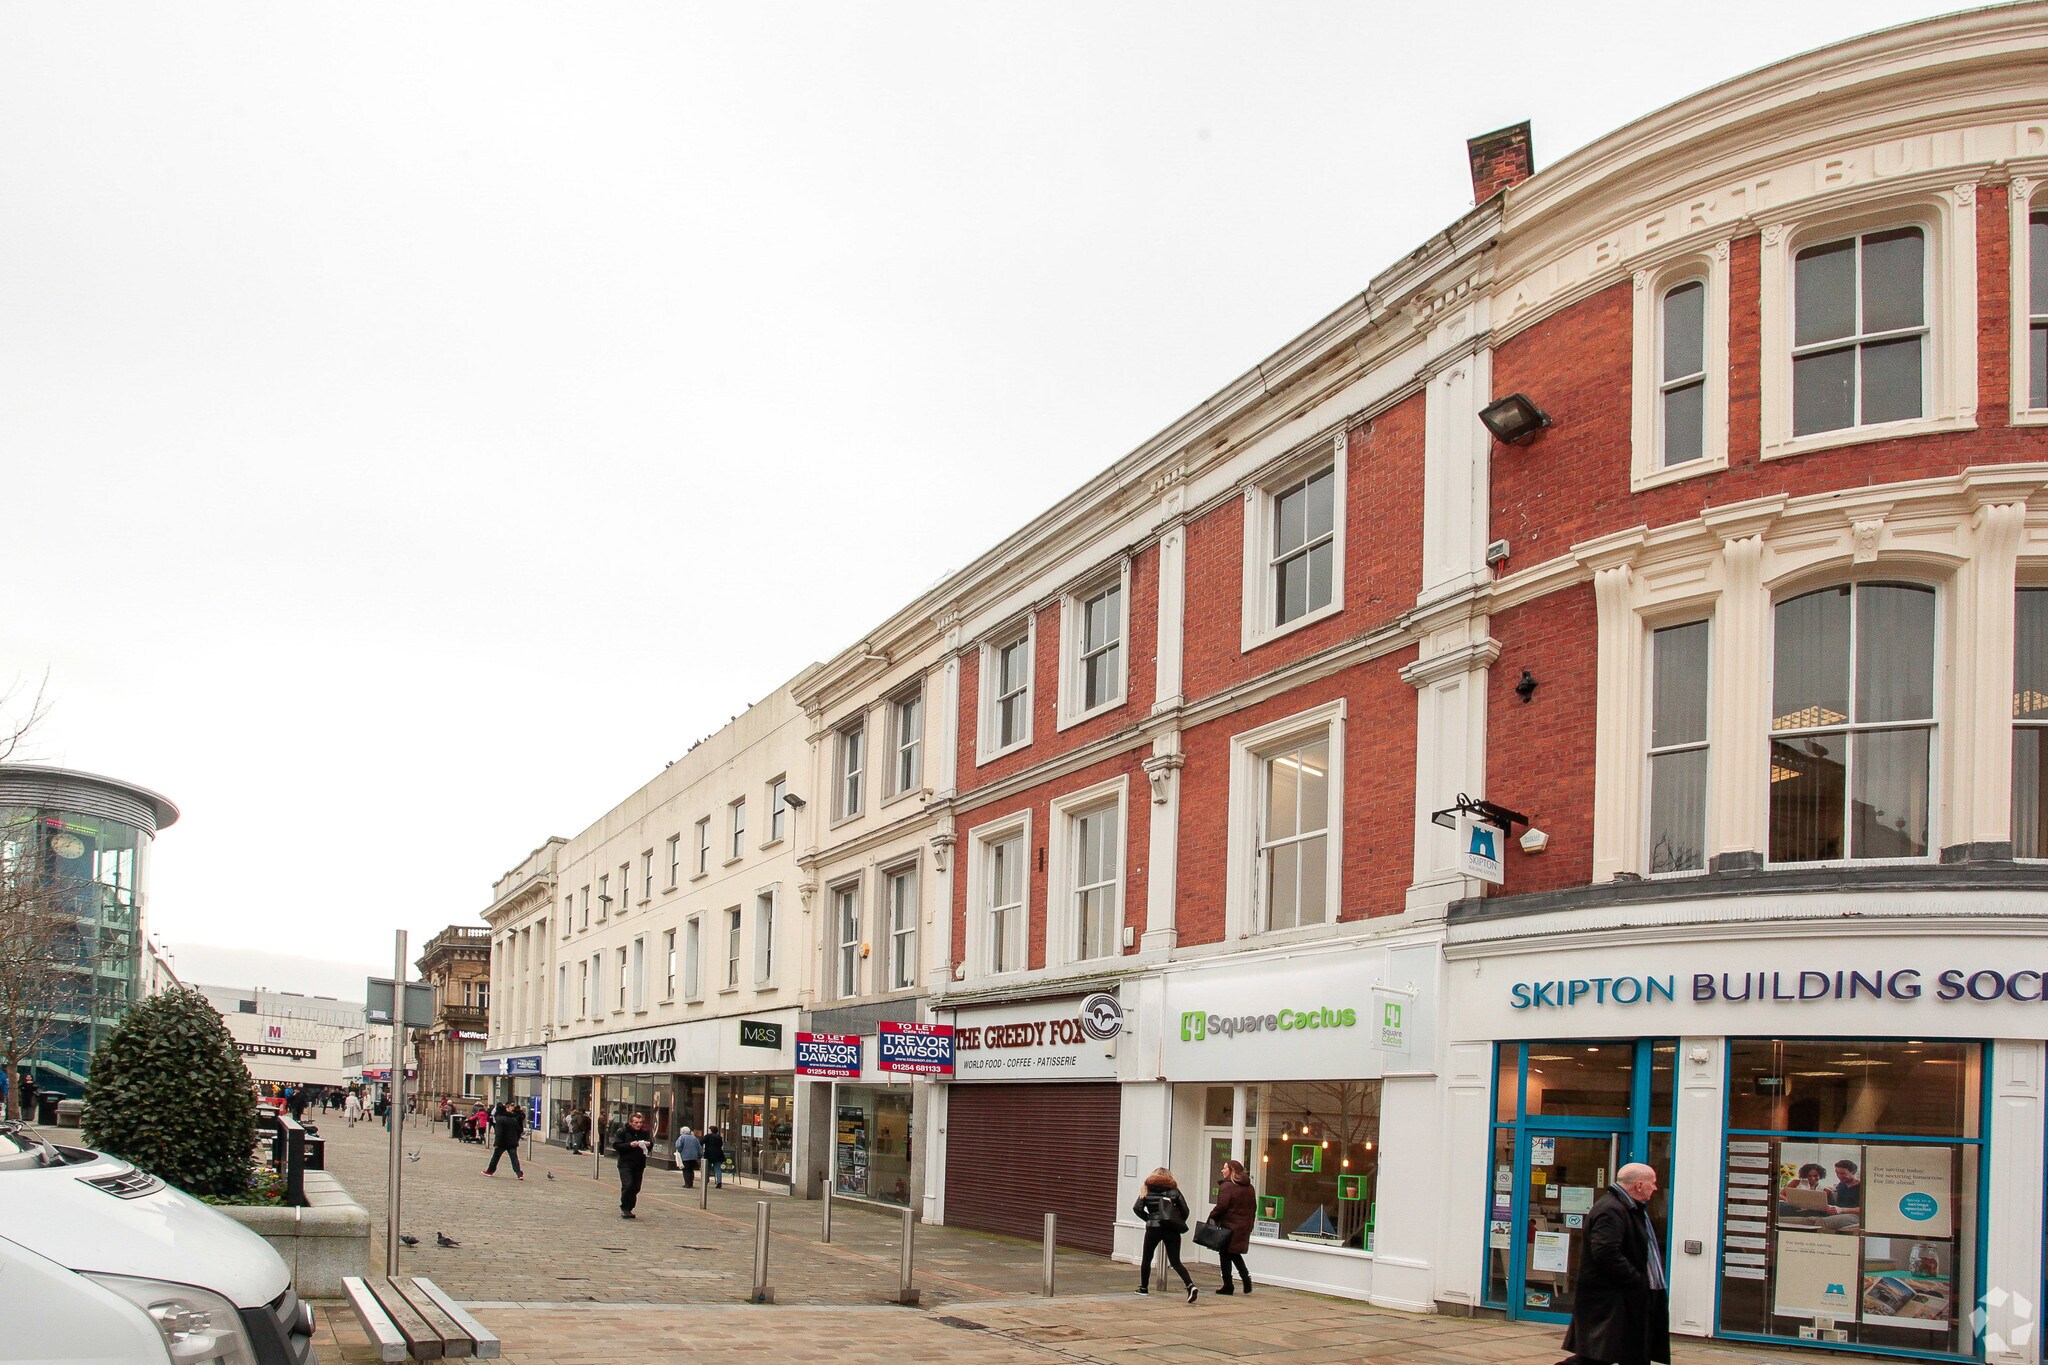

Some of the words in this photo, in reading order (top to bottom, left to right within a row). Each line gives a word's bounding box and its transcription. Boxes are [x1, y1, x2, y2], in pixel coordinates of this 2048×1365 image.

[1506, 178, 1772, 319] ALBERT
[1468, 854, 1497, 870] SKIPTON
[1510, 975, 1674, 1010] SKIPTON
[1692, 969, 1922, 1002] BUILDING
[1207, 1006, 1356, 1038] SquareCactus
[459, 1031, 488, 1040] NatWest
[744, 1026, 776, 1043] M&S
[955, 1026, 981, 1051] THE
[984, 1021, 1046, 1049] GREEDY
[1050, 1018, 1085, 1046] FOX
[1381, 1027, 1402, 1038] Square
[883, 1034, 949, 1048] TREVOR
[1381, 1034, 1402, 1045] Cactus
[237, 1044, 311, 1057] DEBENHAMS
[800, 1043, 856, 1055] TREVOR
[883, 1044, 949, 1058] DAWSON
[800, 1052, 857, 1064] DAWSON
[963, 1060, 984, 1069] WORLD
[985, 1058, 1002, 1068] FOOD
[1007, 1057, 1031, 1067] COFFEE
[1037, 1056, 1077, 1066] PATISSERIE
[892, 1063, 914, 1071] 01254
[915, 1065, 941, 1073] 681133
